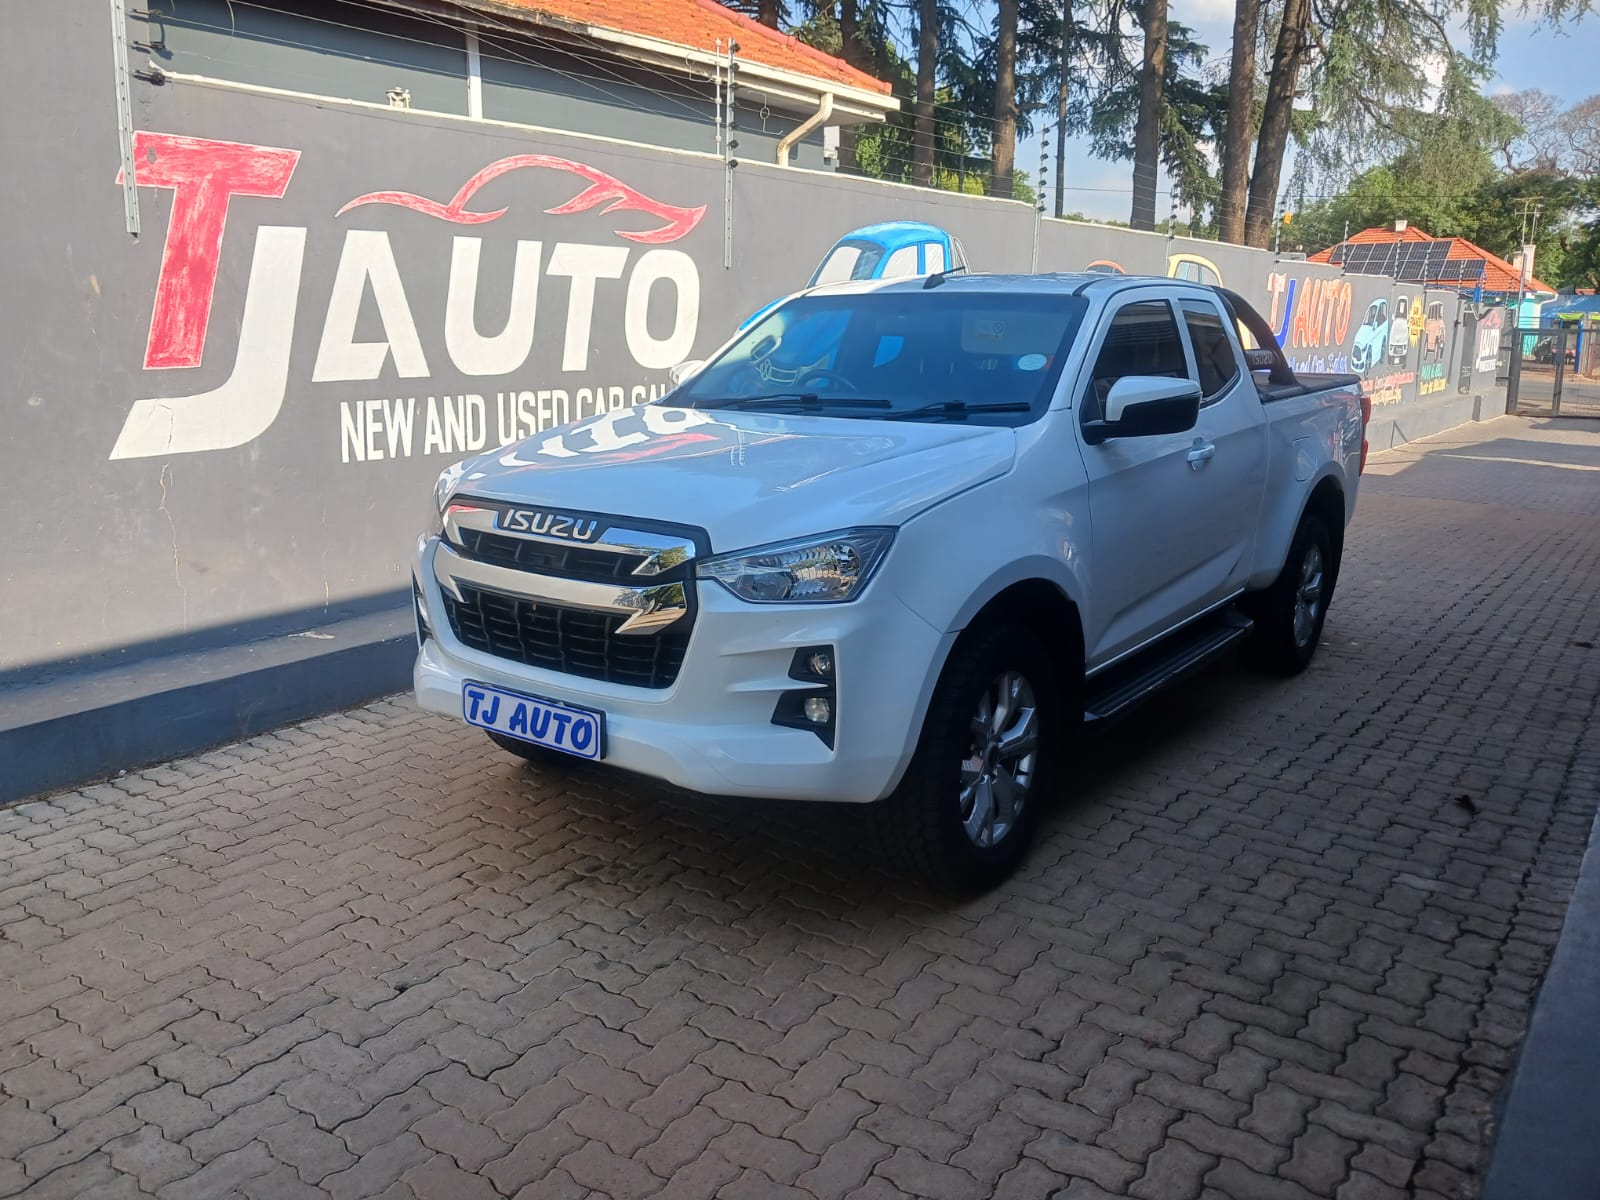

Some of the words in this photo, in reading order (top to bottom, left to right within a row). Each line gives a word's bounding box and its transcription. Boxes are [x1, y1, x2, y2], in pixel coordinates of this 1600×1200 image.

[312, 230, 701, 382] AUTO
[1293, 276, 1352, 348] AUTO
[340, 397, 422, 463] NEW
[424, 394, 486, 455] AND
[497, 389, 569, 447] USED
[502, 508, 598, 540] ISUZU
[467, 689, 498, 725] TJ
[509, 702, 593, 751] AUTO
